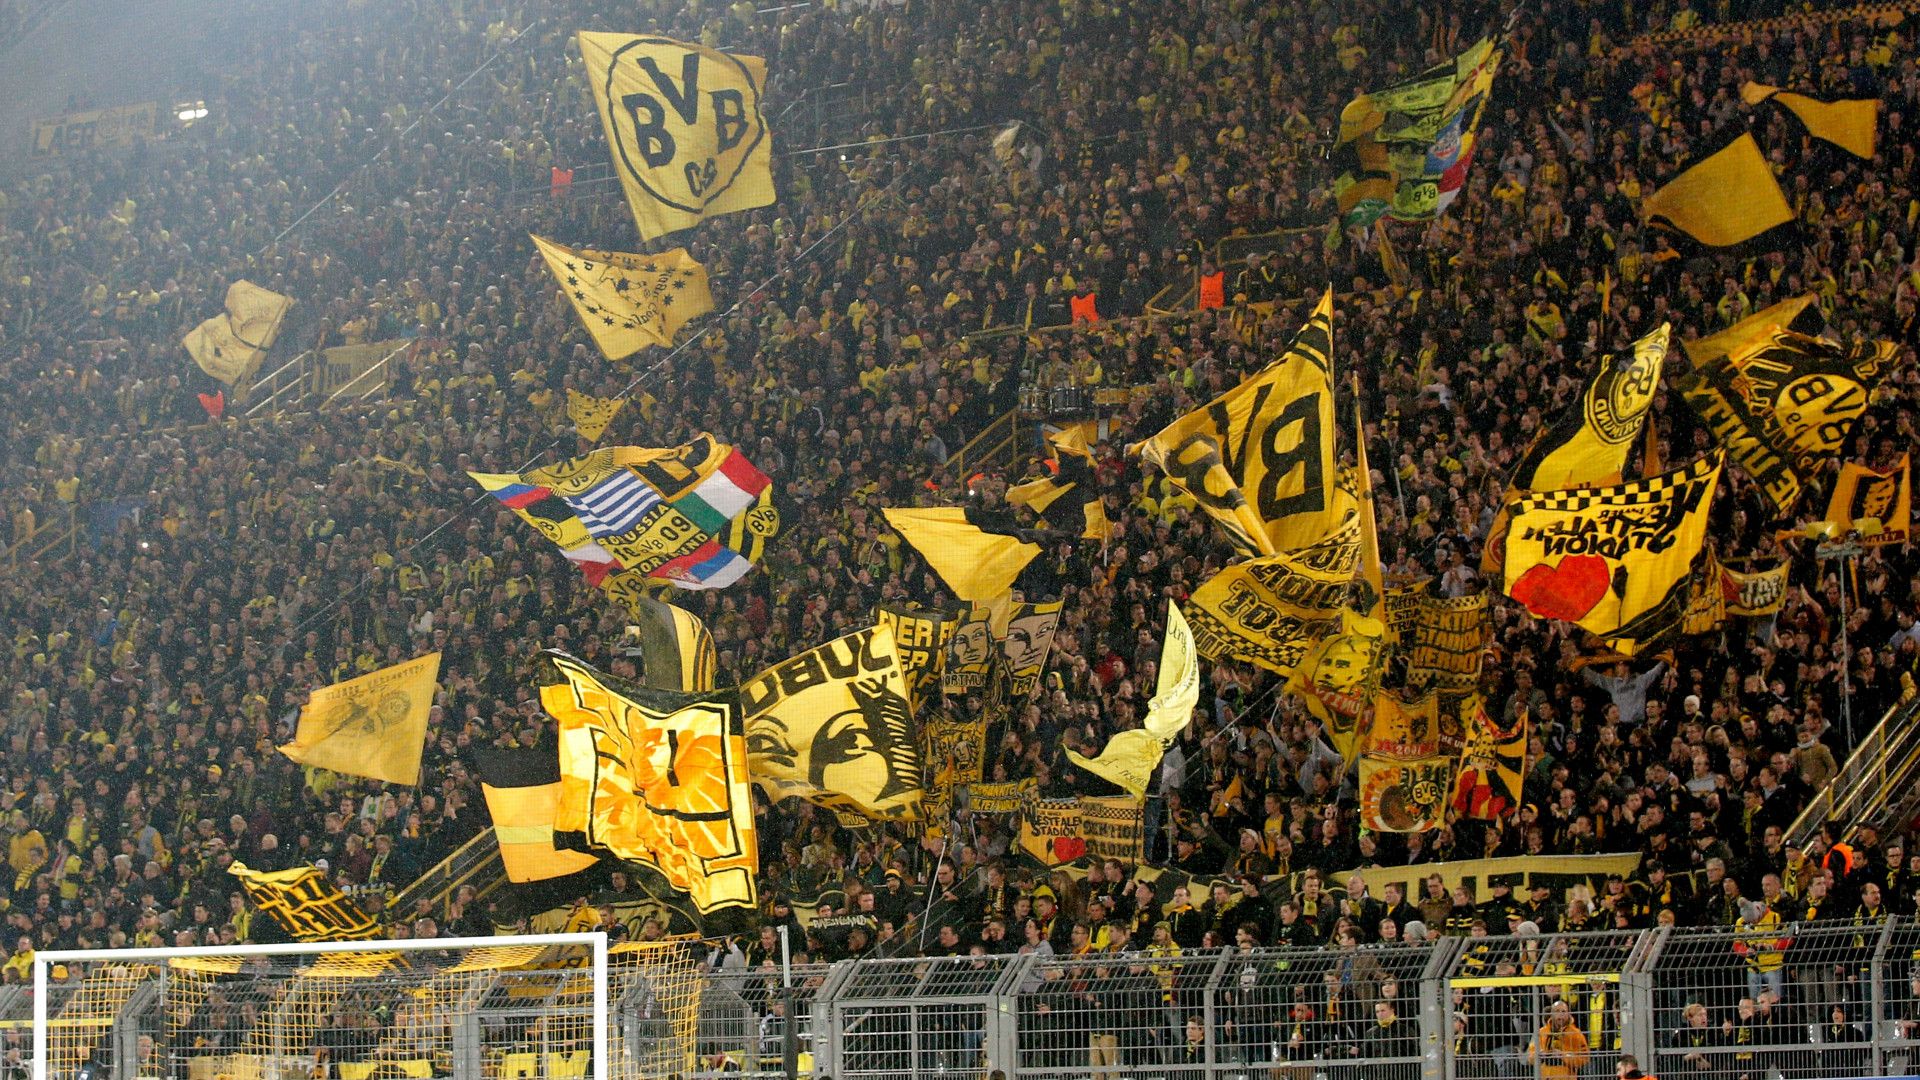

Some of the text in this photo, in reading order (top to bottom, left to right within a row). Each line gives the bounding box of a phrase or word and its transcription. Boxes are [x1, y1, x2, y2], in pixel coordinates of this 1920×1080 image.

[622, 53, 748, 169] BVB
[660, 516, 691, 541] 09
[750, 510, 776, 532] BVB
[1415, 784, 1437, 799] BVB
